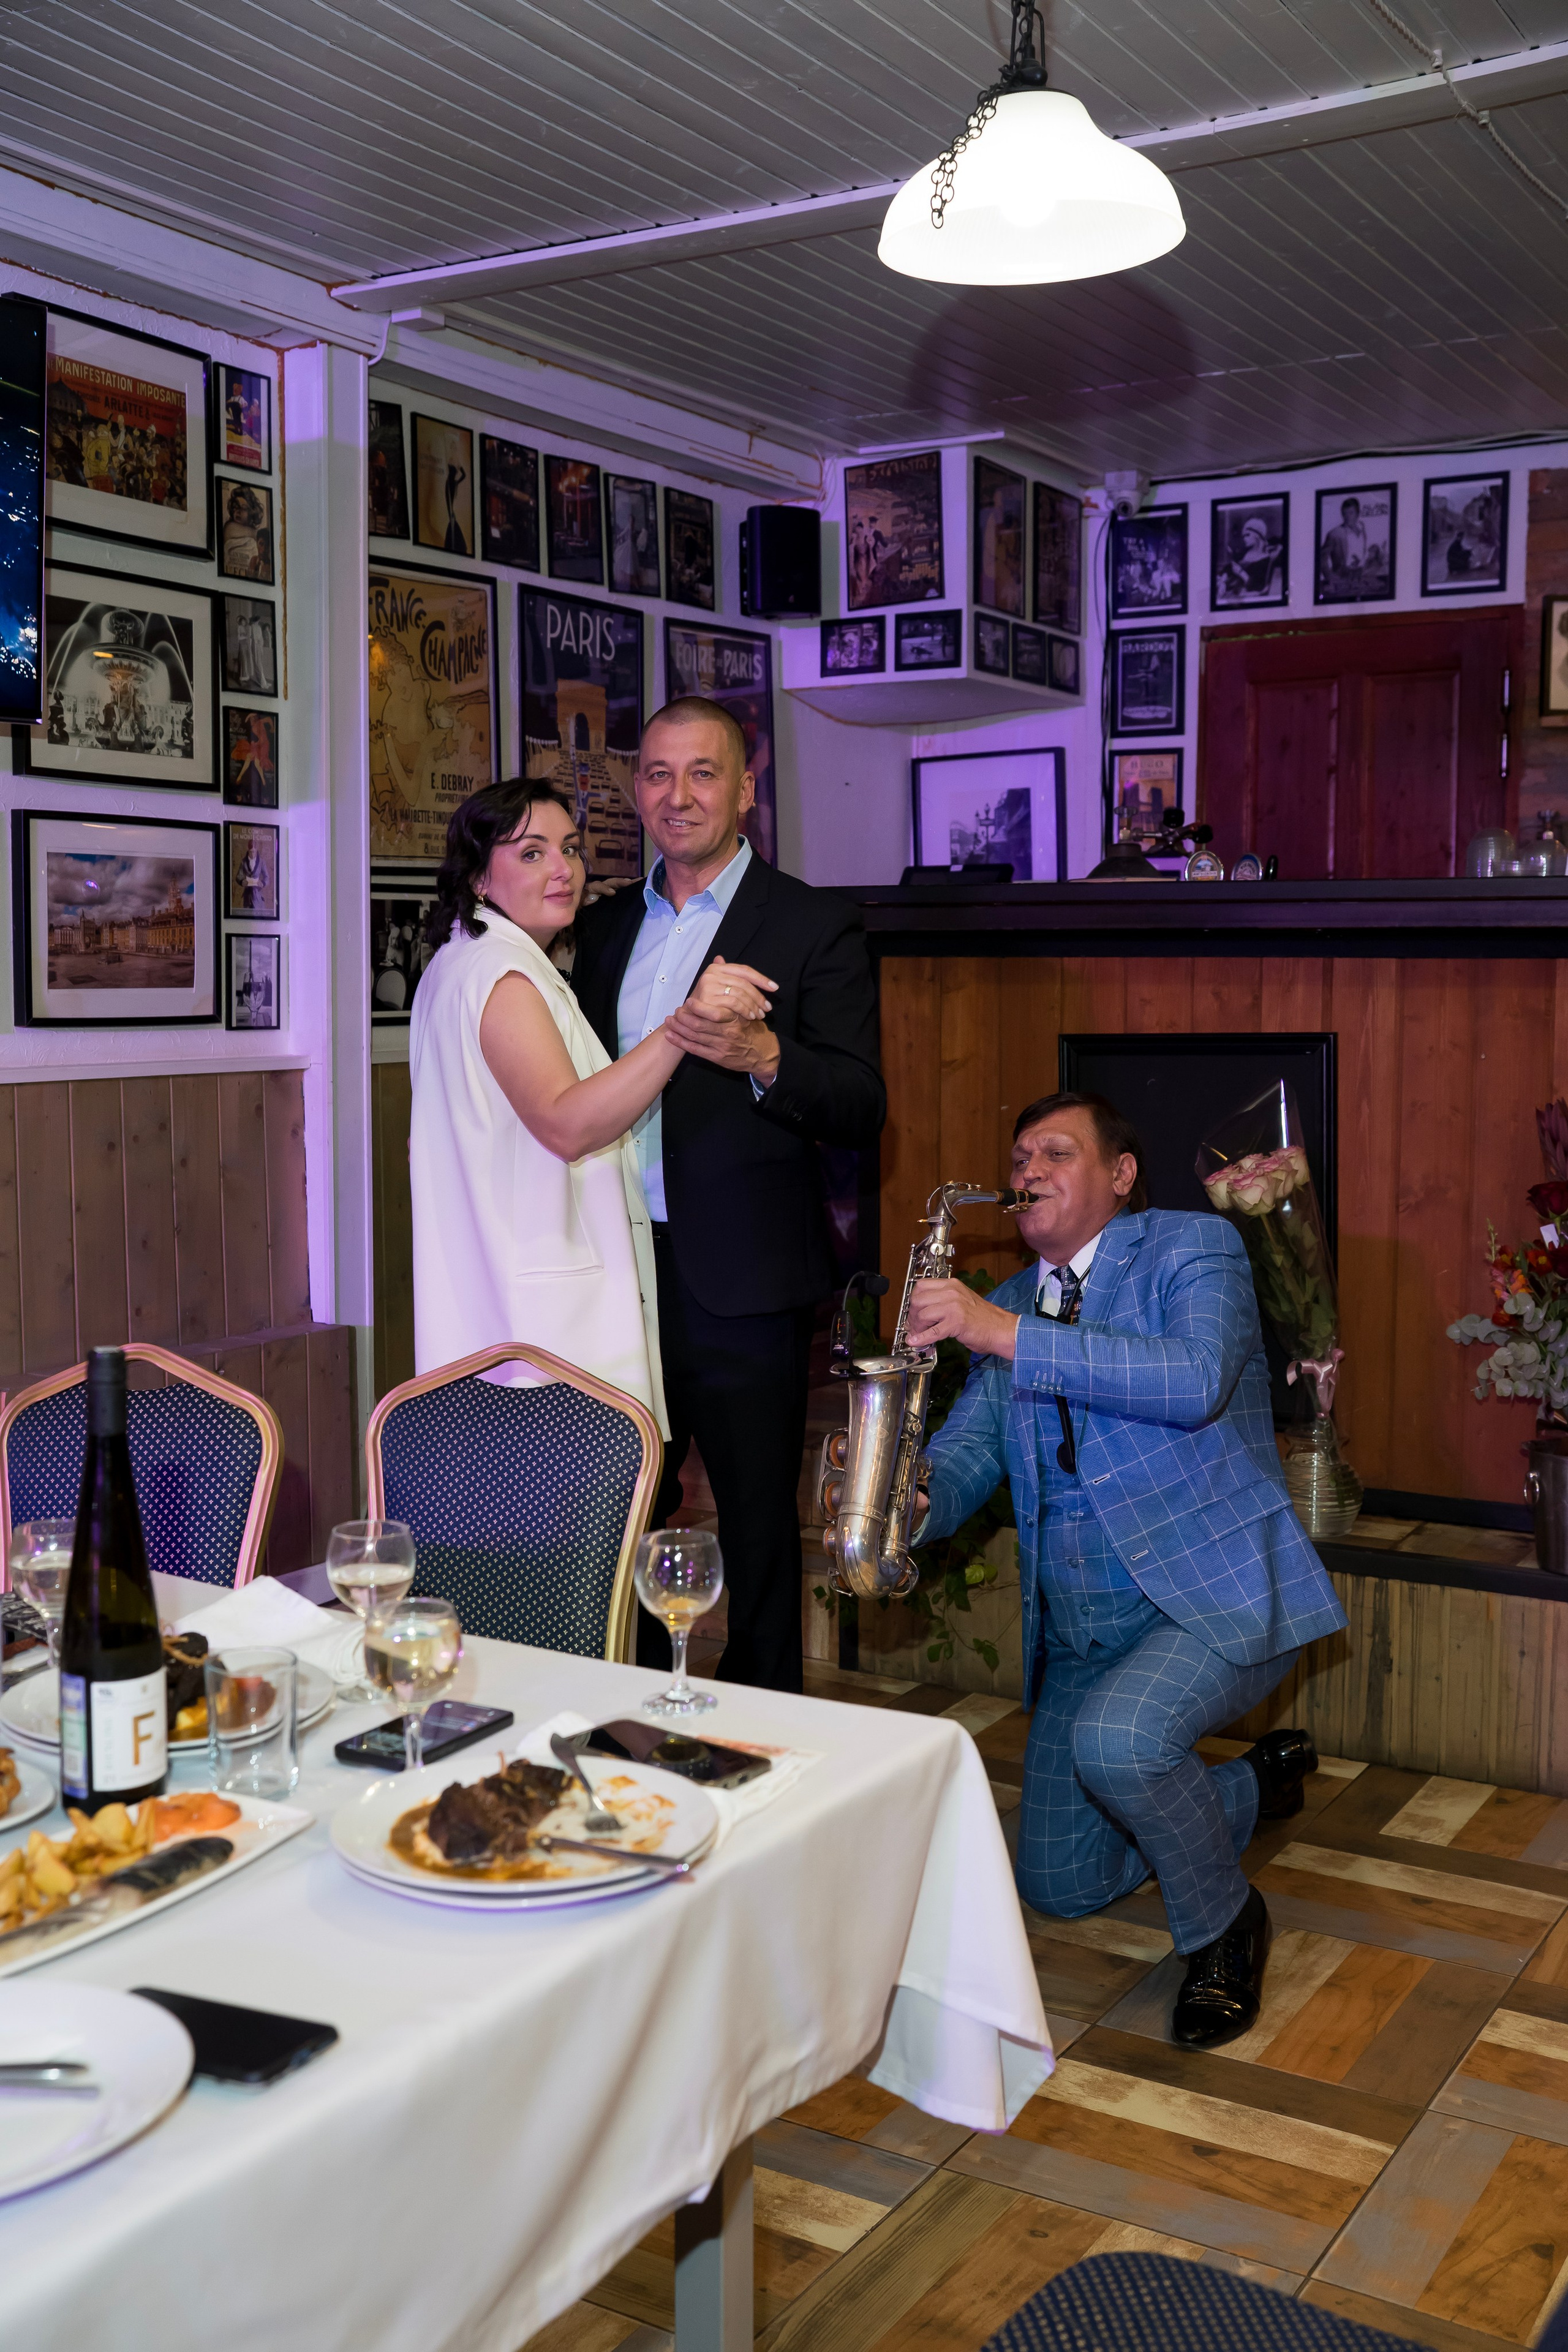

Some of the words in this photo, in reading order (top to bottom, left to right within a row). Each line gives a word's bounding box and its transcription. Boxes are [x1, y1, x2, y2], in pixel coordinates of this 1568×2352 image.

[56, 356, 132, 393] MANIFESTATION
[137, 382, 185, 409] IMPOSANTE
[104, 396, 144, 418] ARLATTE
[420, 620, 487, 684] CHAMPAGNE
[546, 601, 616, 661] PARIS
[676, 641, 715, 674] FOIRE
[723, 649, 763, 680] PARIS
[441, 774, 474, 792] DEBRAY
[134, 1710, 155, 1766] F
